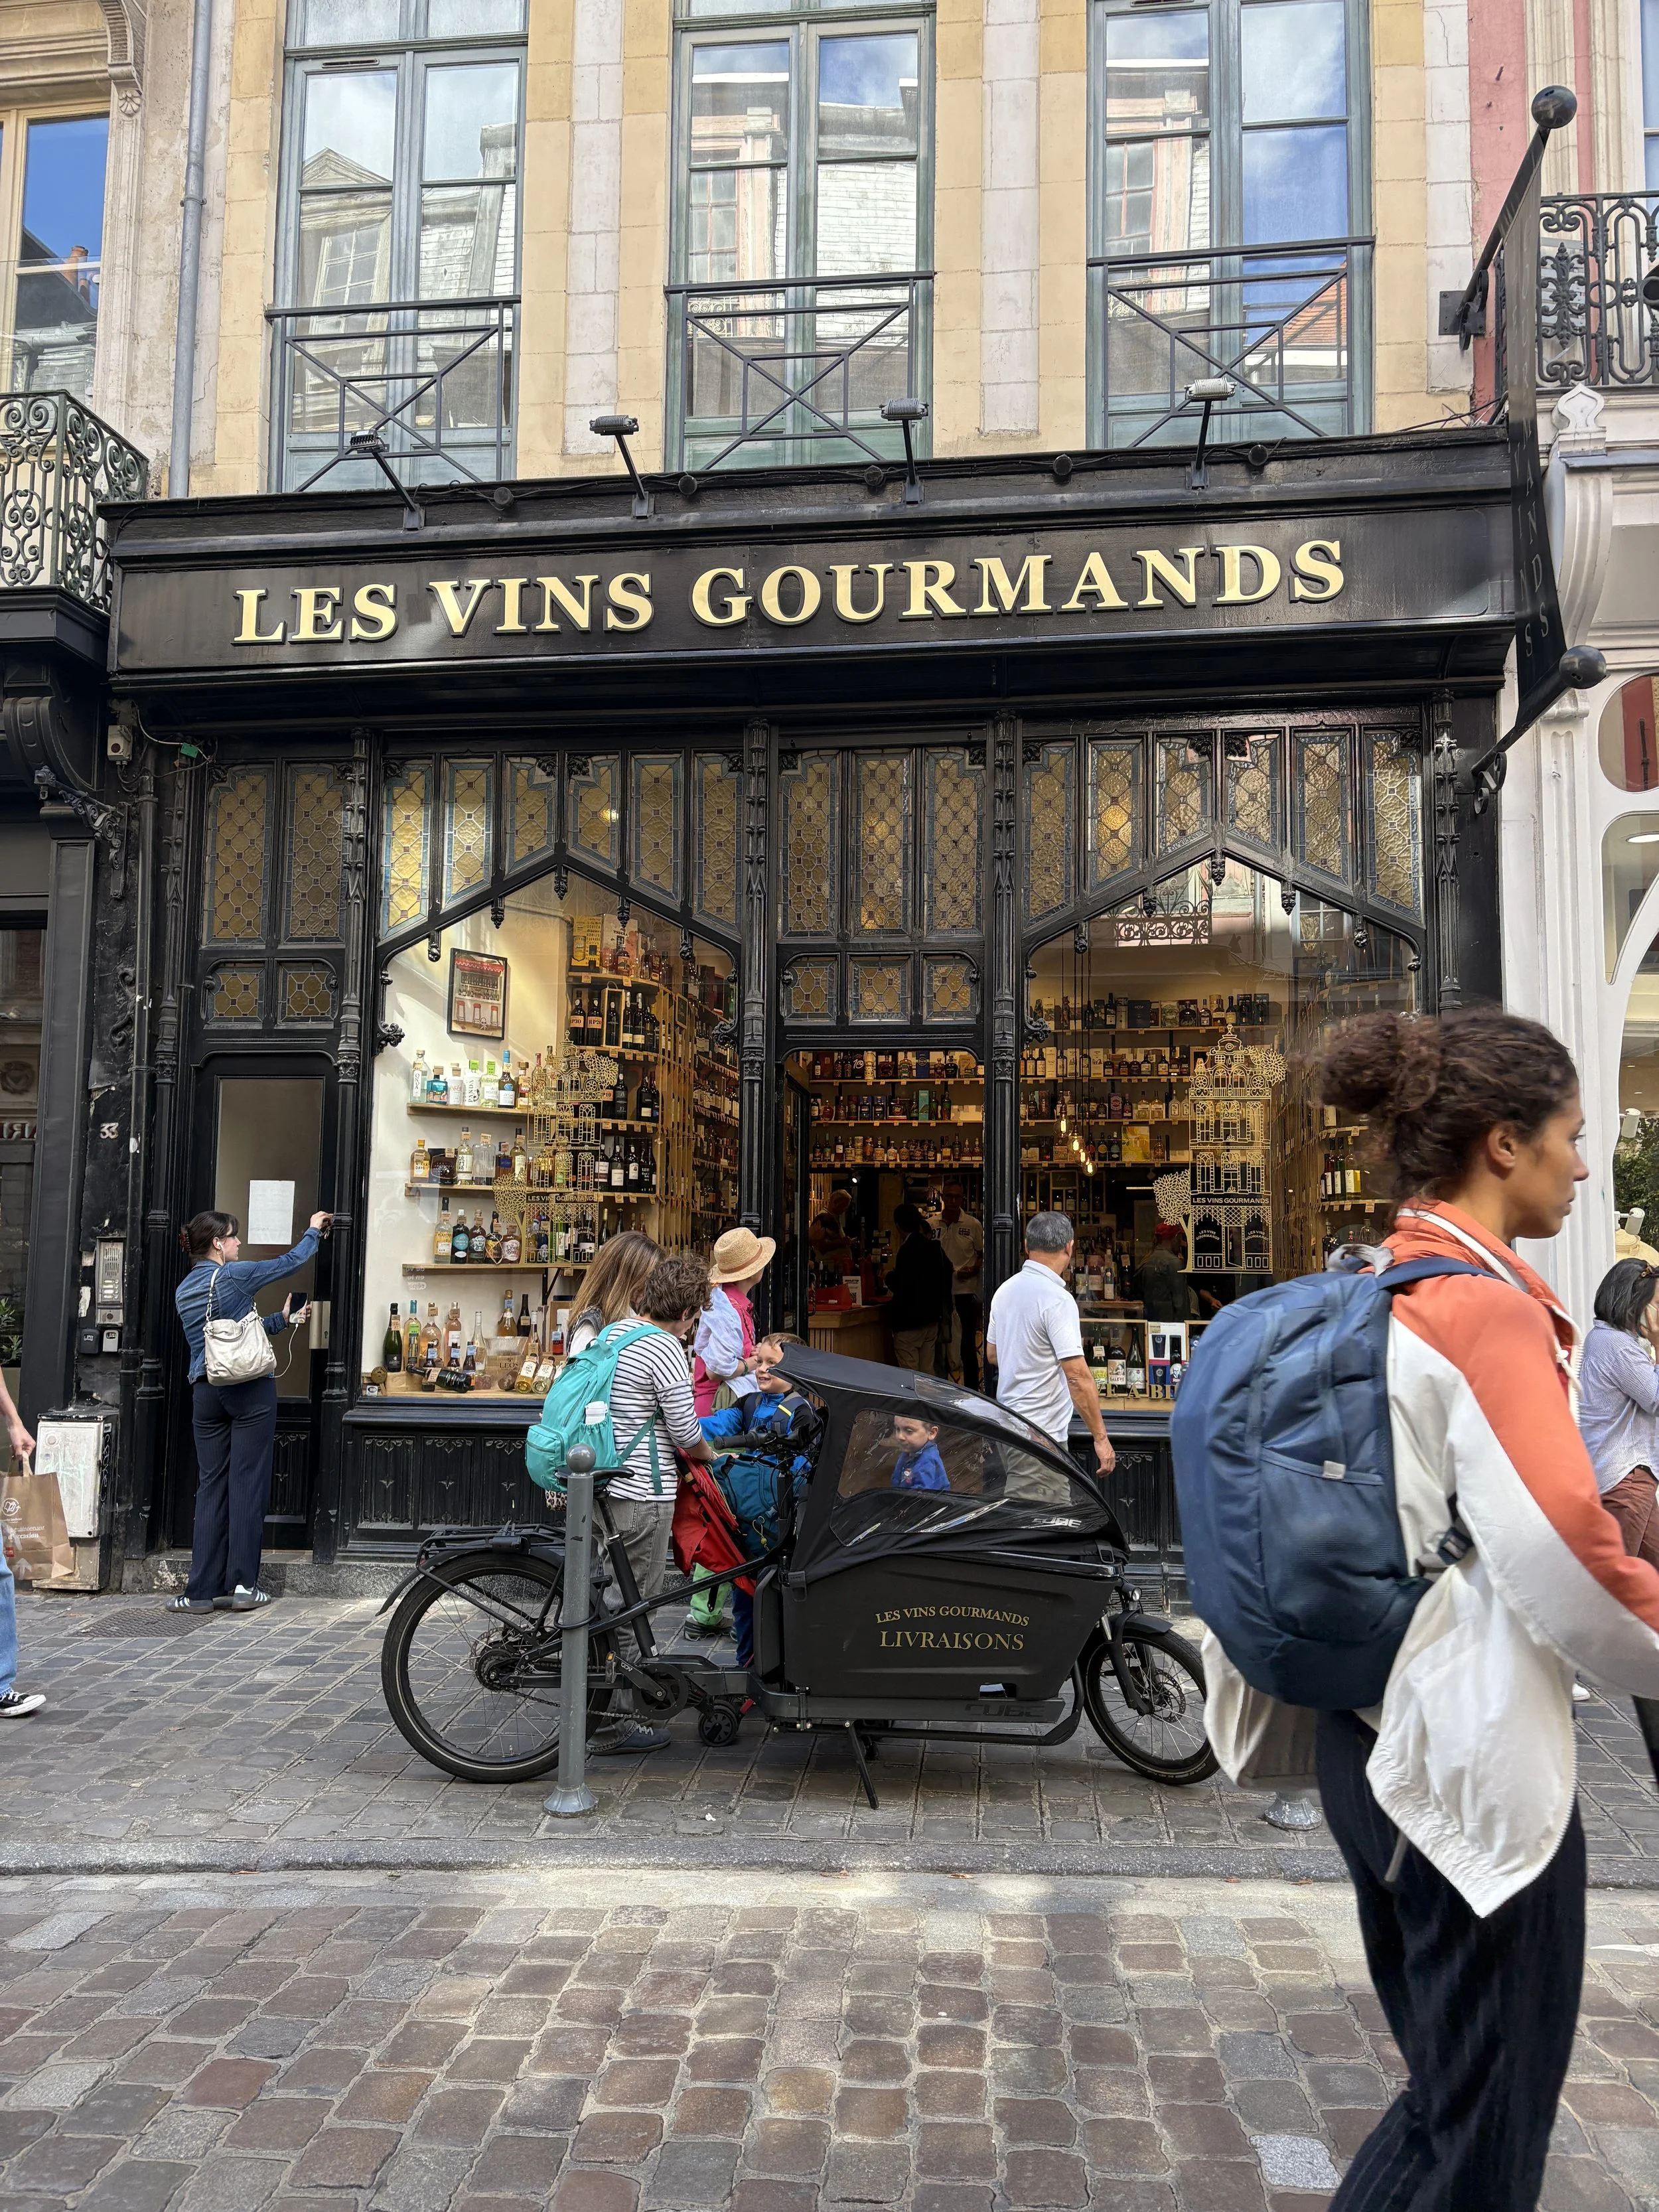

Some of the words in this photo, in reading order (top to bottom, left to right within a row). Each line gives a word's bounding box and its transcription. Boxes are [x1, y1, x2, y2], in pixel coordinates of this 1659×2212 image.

[232, 583, 397, 644] LES
[429, 573, 654, 636] VINS
[691, 540, 1345, 626] GOURMANDS
[100, 1122, 119, 1140] 33
[1127, 1380, 1141, 1398] A
[875, 1609, 901, 1623] LES
[902, 1606, 936, 1619] VINS
[939, 1605, 1030, 1626] GOURMANDS
[879, 1631, 1025, 1651] LIVRAISONS
[965, 1703, 1045, 1718] CUBE
